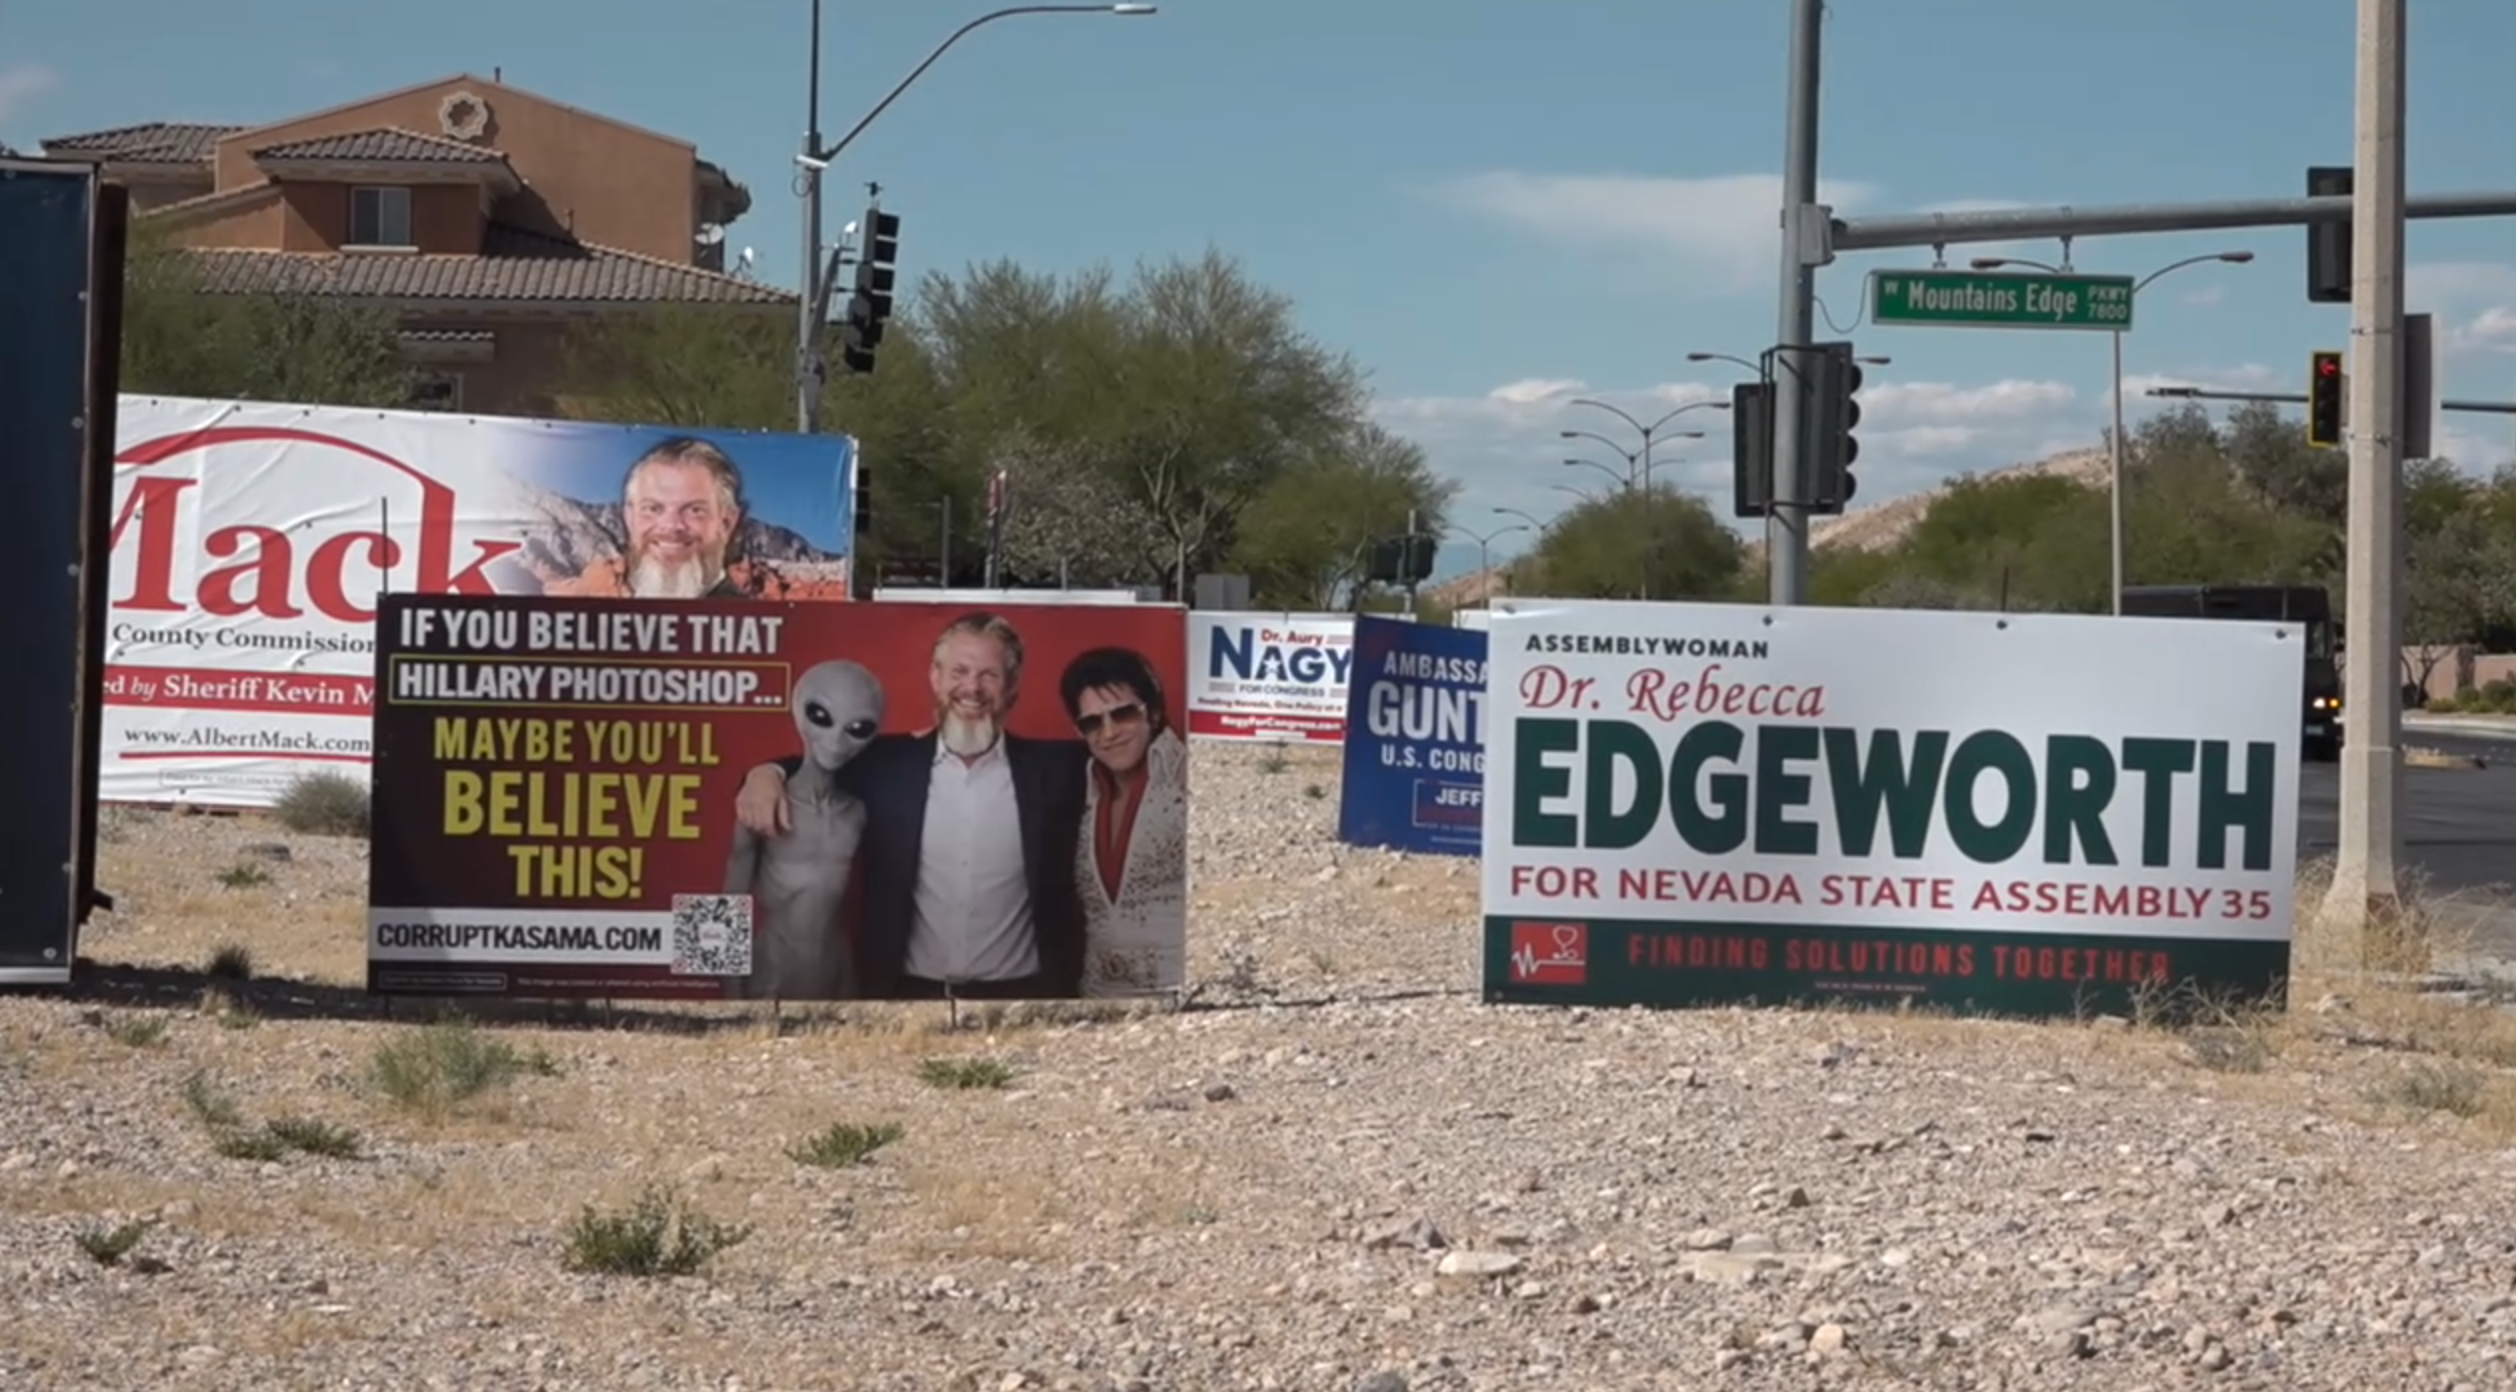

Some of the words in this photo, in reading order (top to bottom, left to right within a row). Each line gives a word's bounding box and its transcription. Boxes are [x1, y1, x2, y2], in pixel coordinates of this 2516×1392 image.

[1884, 281, 1898, 294] W
[1908, 280, 2017, 312] Mountains
[2026, 283, 2077, 321] Edge
[2087, 285, 2129, 300] PKWY
[2087, 303, 2127, 319] 7800
[113, 623, 209, 649] County
[401, 609, 435, 647] IF
[442, 610, 516, 648] YOU
[528, 611, 678, 652] BELIEVE
[688, 615, 782, 654] THAT
[1261, 628, 1282, 642] Dr.
[1287, 630, 1323, 645] Aury
[1525, 634, 1768, 659] ASSEMBLYWOMAN
[1209, 625, 1351, 684] NAGY
[130, 675, 157, 702] by
[163, 674, 261, 700] Sheriff
[266, 679, 344, 704] Kevin
[398, 663, 544, 699] HILLARY
[550, 667, 782, 705] PHOTOSHOP...
[1240, 685, 1261, 695] FOR
[1264, 685, 1325, 697] CONGRESS
[1519, 664, 1599, 709] Dr.
[1627, 664, 1825, 722] Rebecca
[124, 728, 370, 751] www.AlbertMack.com
[434, 717, 574, 762] MAYBE
[585, 721, 719, 764] YOU'LL
[1381, 744, 1423, 768] U.S.
[443, 770, 701, 838] BELIEVE
[1435, 787, 1482, 807] JEFF
[1512, 717, 2275, 871] EDGEWORTH
[508, 845, 643, 898] THIS!
[1511, 865, 1599, 899] FOR
[1619, 869, 1803, 905] NEVADA
[1820, 875, 1953, 909] STATE
[1972, 880, 2213, 918] ASSEMBLY
[2220, 890, 2271, 919] 35
[377, 922, 661, 951] CORRUPTKASAMA.COM
[1627, 934, 1768, 969] FINDING
[1786, 939, 1974, 976] SOLUTIONS
[1993, 946, 2170, 983] TOGETHER
